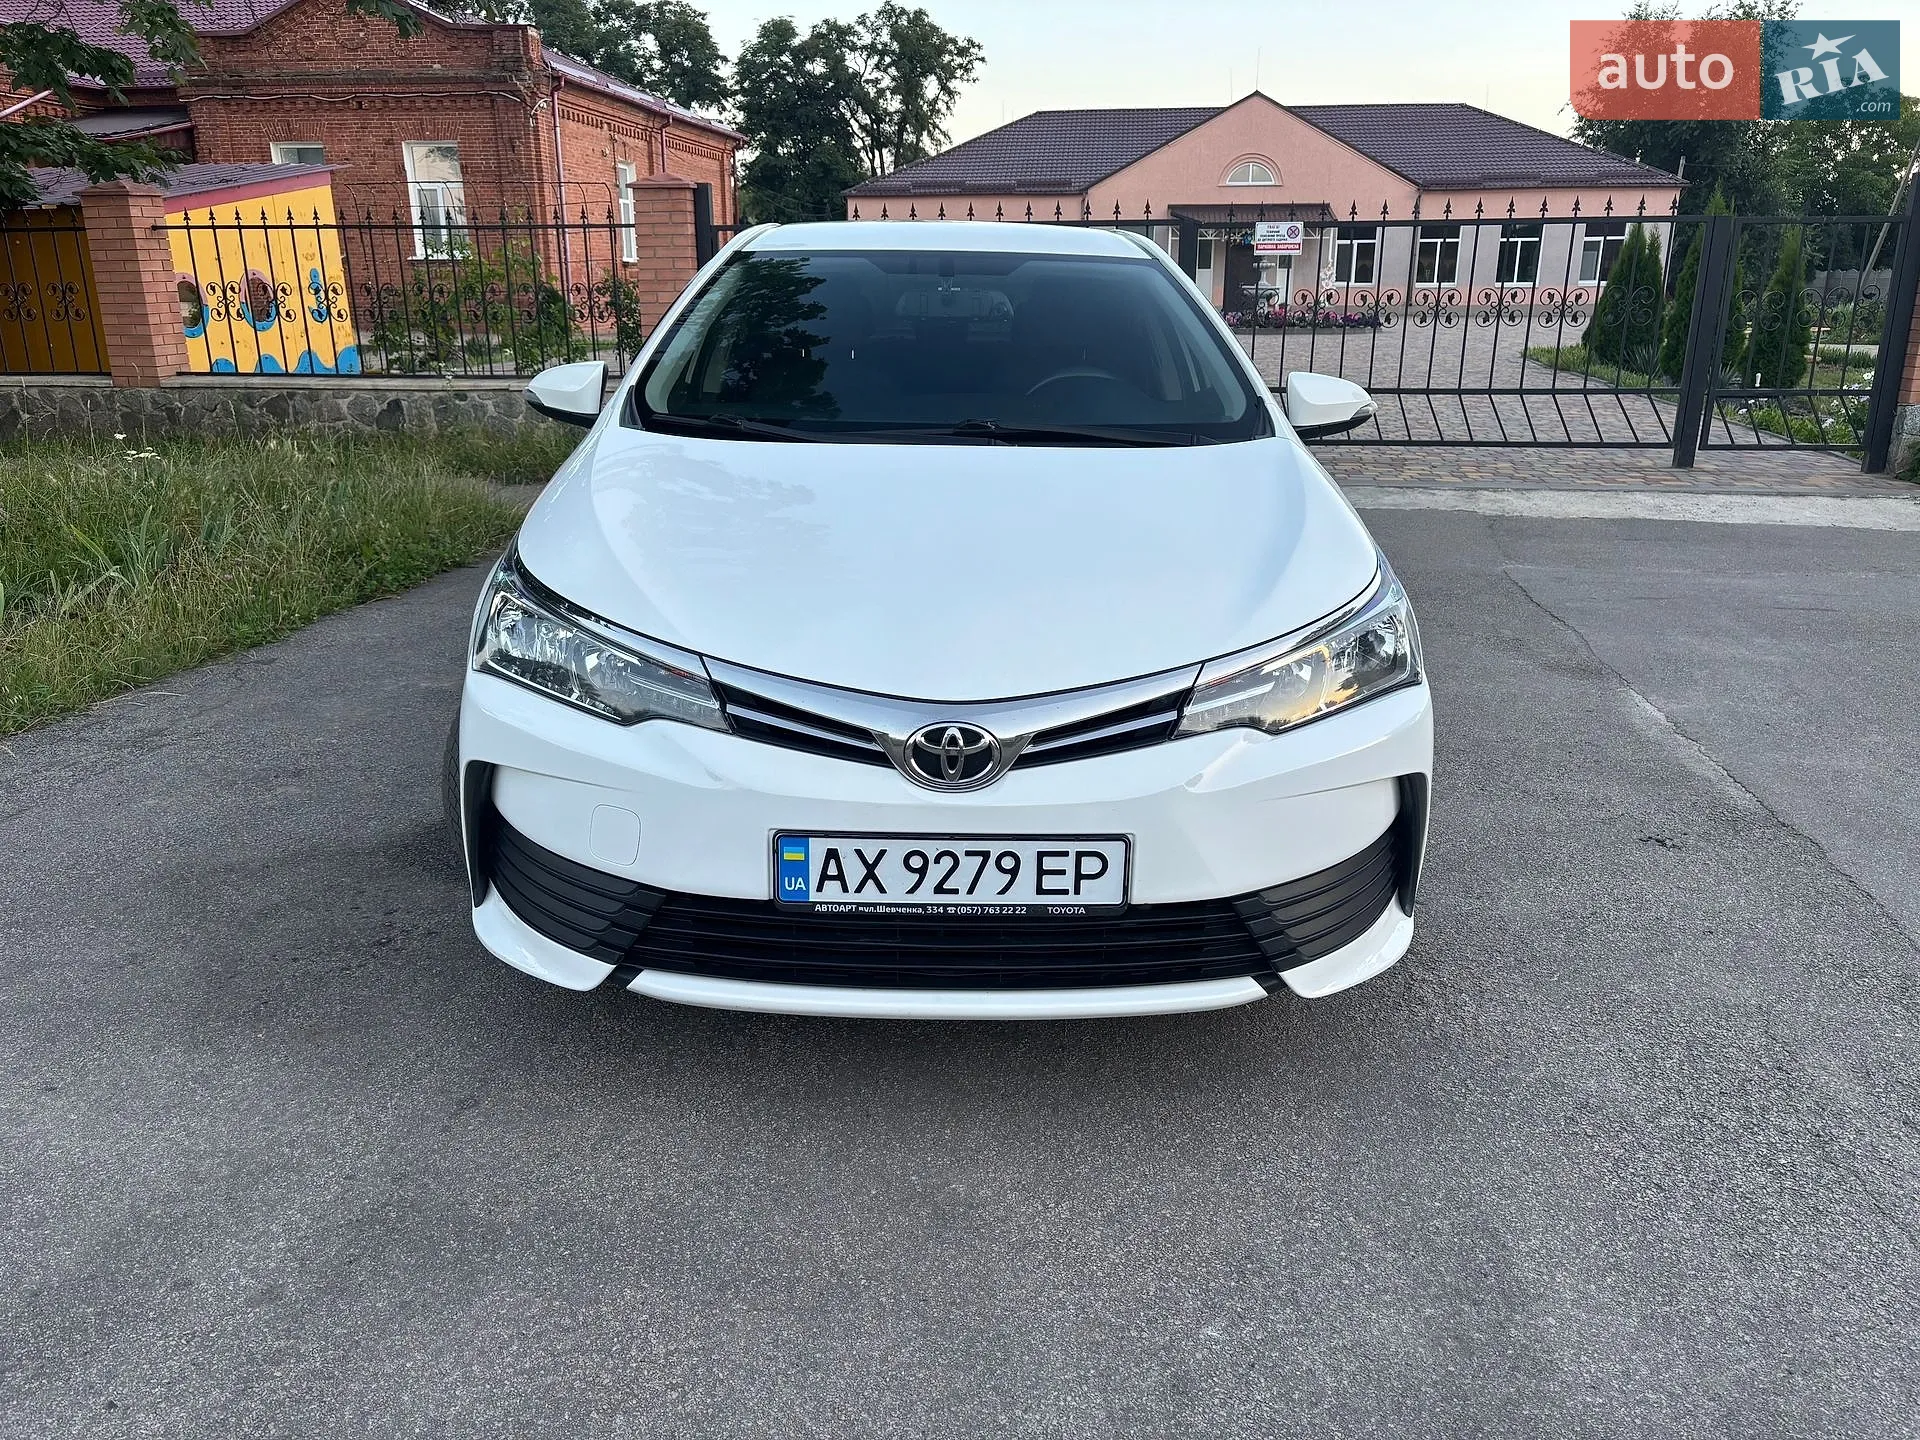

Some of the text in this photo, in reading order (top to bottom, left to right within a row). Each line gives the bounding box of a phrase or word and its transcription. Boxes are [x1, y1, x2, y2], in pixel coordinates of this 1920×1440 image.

[902, 848, 1022, 896] 9279
[784, 876, 807, 891] UA
[926, 905, 944, 914] 334
[957, 906, 982, 916] (057)
[983, 906, 1000, 915] 763
[1001, 906, 1014, 915] 22
[1015, 906, 1028, 915] 22
[1046, 906, 1086, 915] TOYOTA
